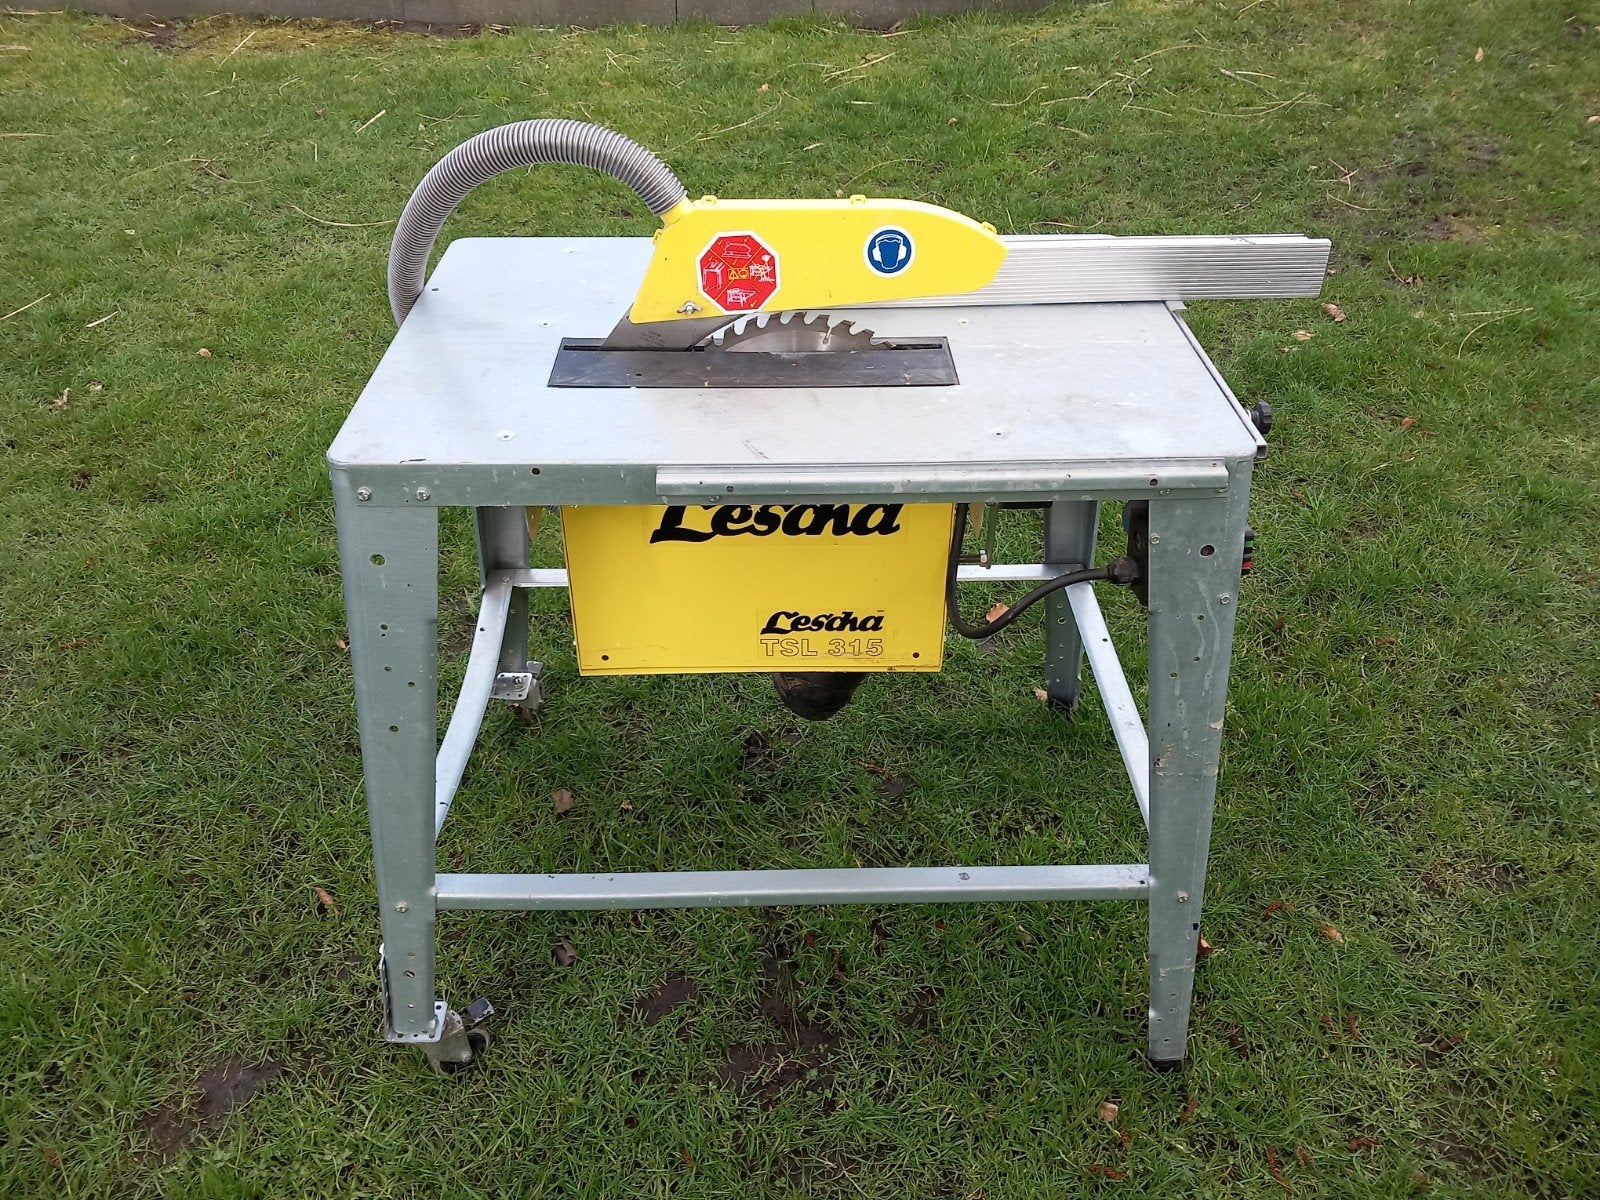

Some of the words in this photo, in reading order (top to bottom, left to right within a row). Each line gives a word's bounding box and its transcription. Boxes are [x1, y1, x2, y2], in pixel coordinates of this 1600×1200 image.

[760, 611, 884, 635] Lescha
[760, 638, 818, 656] TSL
[828, 638, 884, 656] 315
